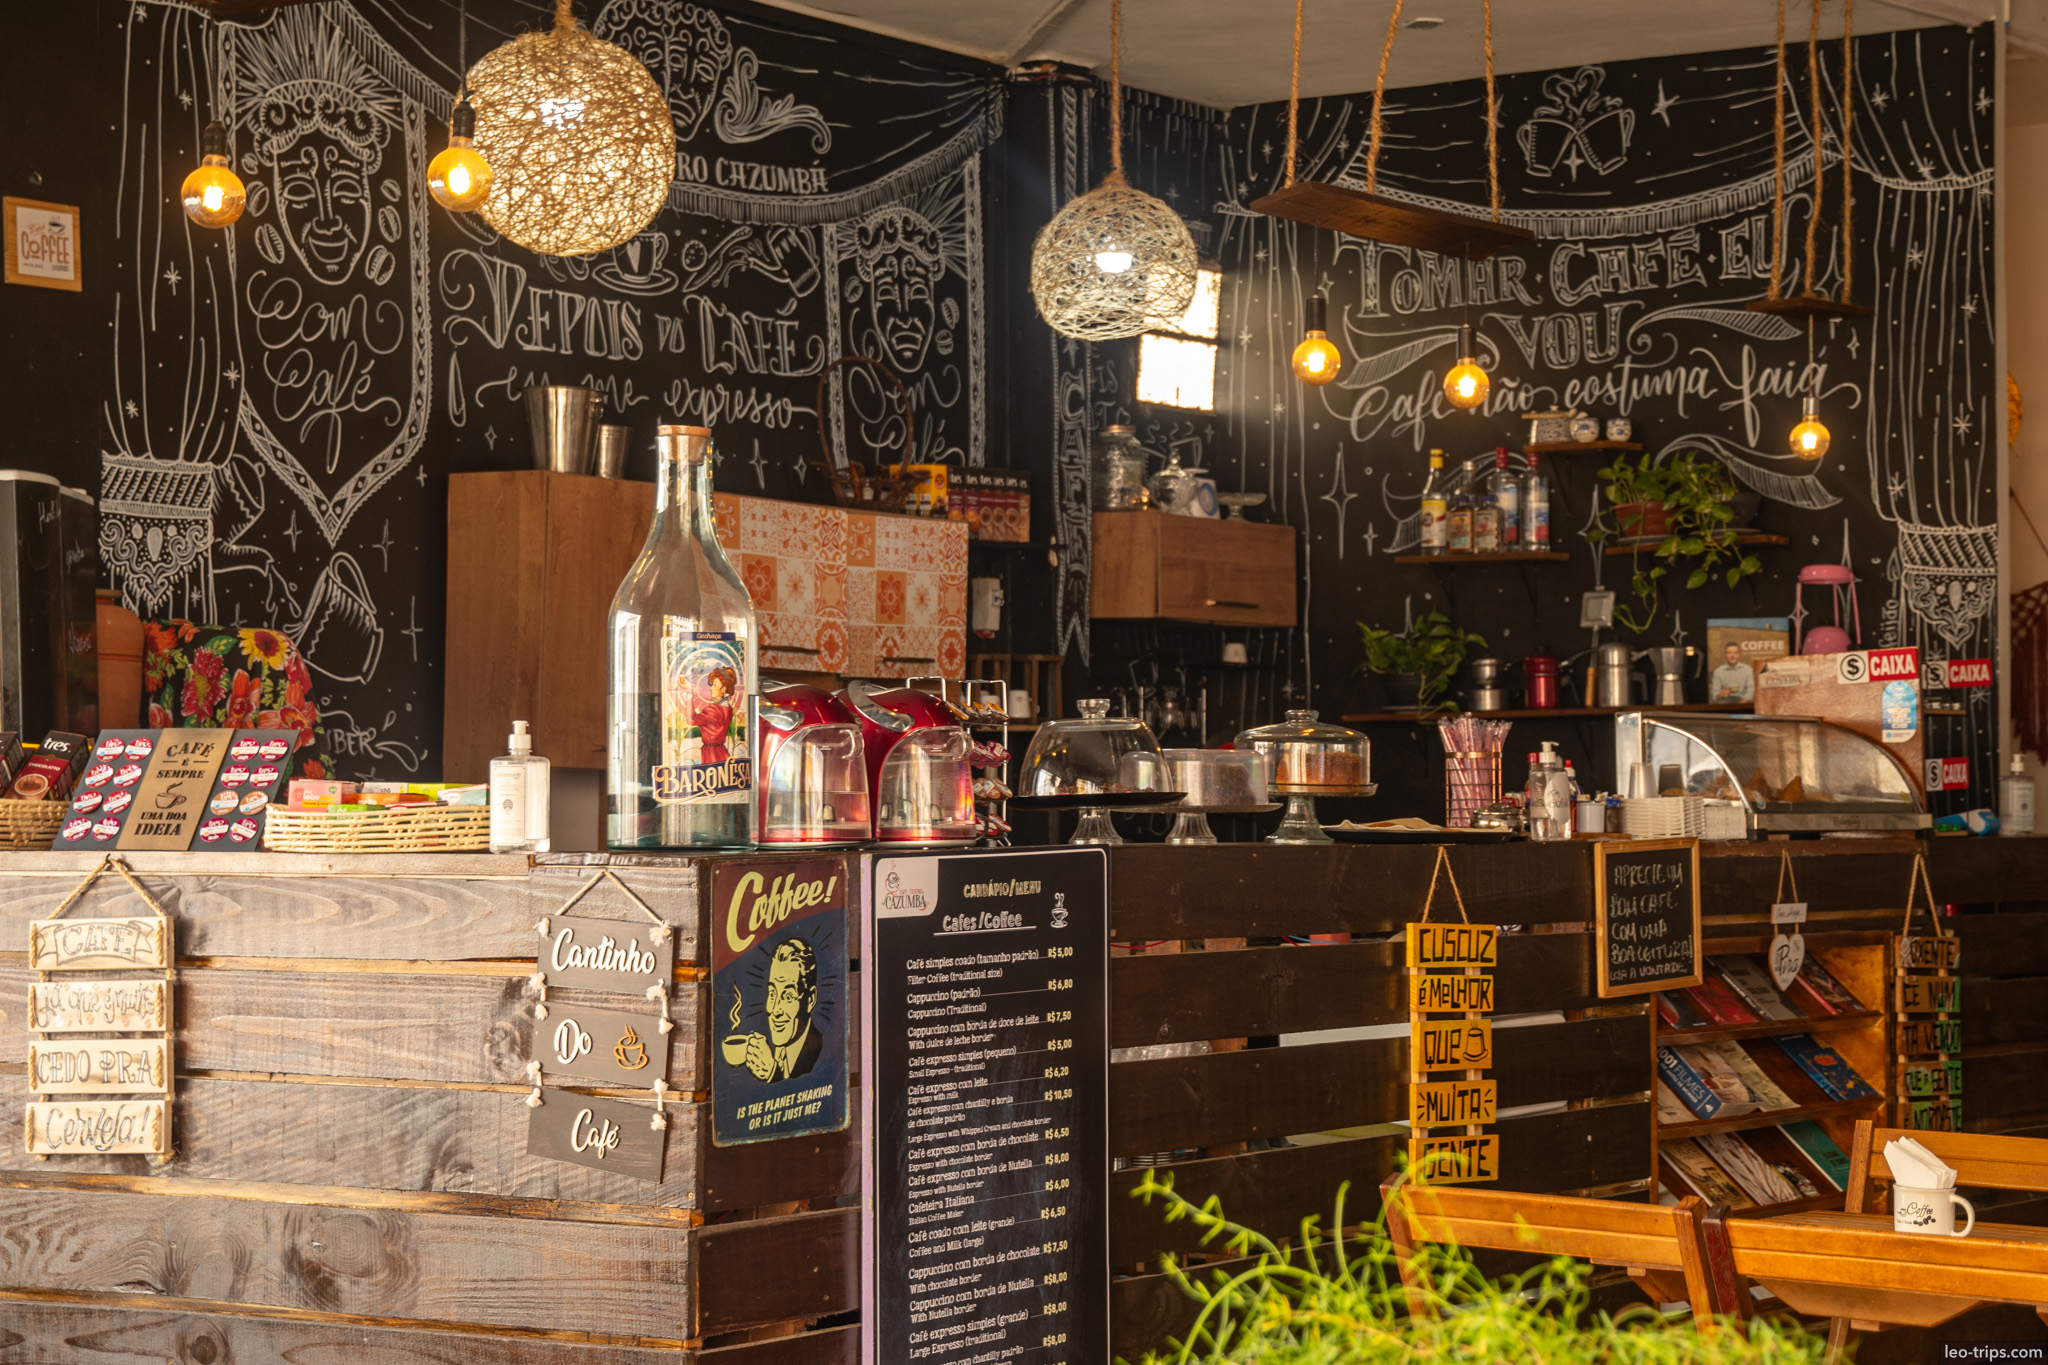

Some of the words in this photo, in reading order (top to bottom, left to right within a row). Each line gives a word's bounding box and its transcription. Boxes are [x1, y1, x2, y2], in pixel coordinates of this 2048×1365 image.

[716, 158, 829, 193] CAZUMBÁ
[21, 231, 70, 265] COFFEE
[1333, 242, 1543, 318] TOMAR
[1549, 228, 1707, 305] CAFÉ
[440, 247, 643, 360] DEPOIS
[684, 294, 825, 376] CAFÉ
[1480, 301, 1645, 369] VOU
[1565, 342, 1718, 419] costuma
[664, 377, 818, 429] expresso
[1741, 640, 1785, 651] COFFEE
[1870, 653, 1916, 678] CAIXA
[1949, 662, 1990, 684] CAIXA
[167, 741, 215, 758] CAFÉ
[182, 757, 189, 766] É
[156, 769, 206, 779] SEMPRE
[654, 755, 752, 797] BARONESA
[1942, 762, 1968, 783] CAIXA
[134, 823, 182, 836] IDEIA
[141, 811, 164, 821] UMA
[166, 811, 187, 821] BOA
[726, 871, 838, 953] Coffee!
[942, 913, 977, 932] Cafes
[1611, 922, 1637, 943] COM
[1640, 918, 1668, 940] UMA
[551, 927, 656, 974] Cantinho
[907, 958, 924, 970] Café
[925, 956, 953, 969] simples
[955, 955, 975, 966] coado
[977, 952, 1010, 964] (tamanho
[1012, 949, 1039, 963] padrão)
[1419, 927, 1494, 964] CUSCUZ
[68, 987, 101, 1025] que
[907, 991, 949, 1004] Cappuccino
[950, 987, 981, 1001] (padrão)
[908, 1006, 946, 1019] Cappuccino
[553, 1018, 593, 1064] Do
[37, 1050, 90, 1085] CEDO
[99, 1050, 156, 1085] PRA
[909, 1056, 925, 1067] Café
[926, 1052, 957, 1066] expresso
[958, 1050, 983, 1062] simples
[907, 1084, 925, 1096] Café
[925, 1082, 957, 1094] expresso
[958, 1081, 972, 1090] com
[974, 1077, 988, 1088] leite
[1673, 1065, 1706, 1100] FILMES
[736, 1107, 746, 1120] IS
[748, 1103, 763, 1117] THE
[765, 1096, 795, 1113] PLANET
[797, 1084, 833, 1105] SHAKING
[749, 1117, 761, 1131] OR
[763, 1115, 771, 1128] IS
[773, 1113, 781, 1126] IT
[782, 1108, 803, 1123] JUST
[805, 1101, 822, 1119] ME?
[45, 1104, 150, 1152] Cerveja!
[571, 1108, 620, 1159] Café
[908, 1200, 944, 1214] Cafeteira
[945, 1194, 975, 1208] Italiana
[1907, 1202, 1933, 1218] Coffee
[908, 1231, 927, 1244] Café
[929, 1226, 951, 1240] coado
[953, 1224, 969, 1235] com
[971, 1220, 987, 1233] leite
[988, 1216, 1015, 1231] (grande)
[909, 1245, 931, 1258] Coffee
[947, 1239, 963, 1251] Milk
[909, 1295, 954, 1312] Cappuccino
[956, 1291, 972, 1302] com
[974, 1285, 996, 1299] borda
[997, 1282, 1007, 1294] de
[1008, 1277, 1034, 1292] Nutella
